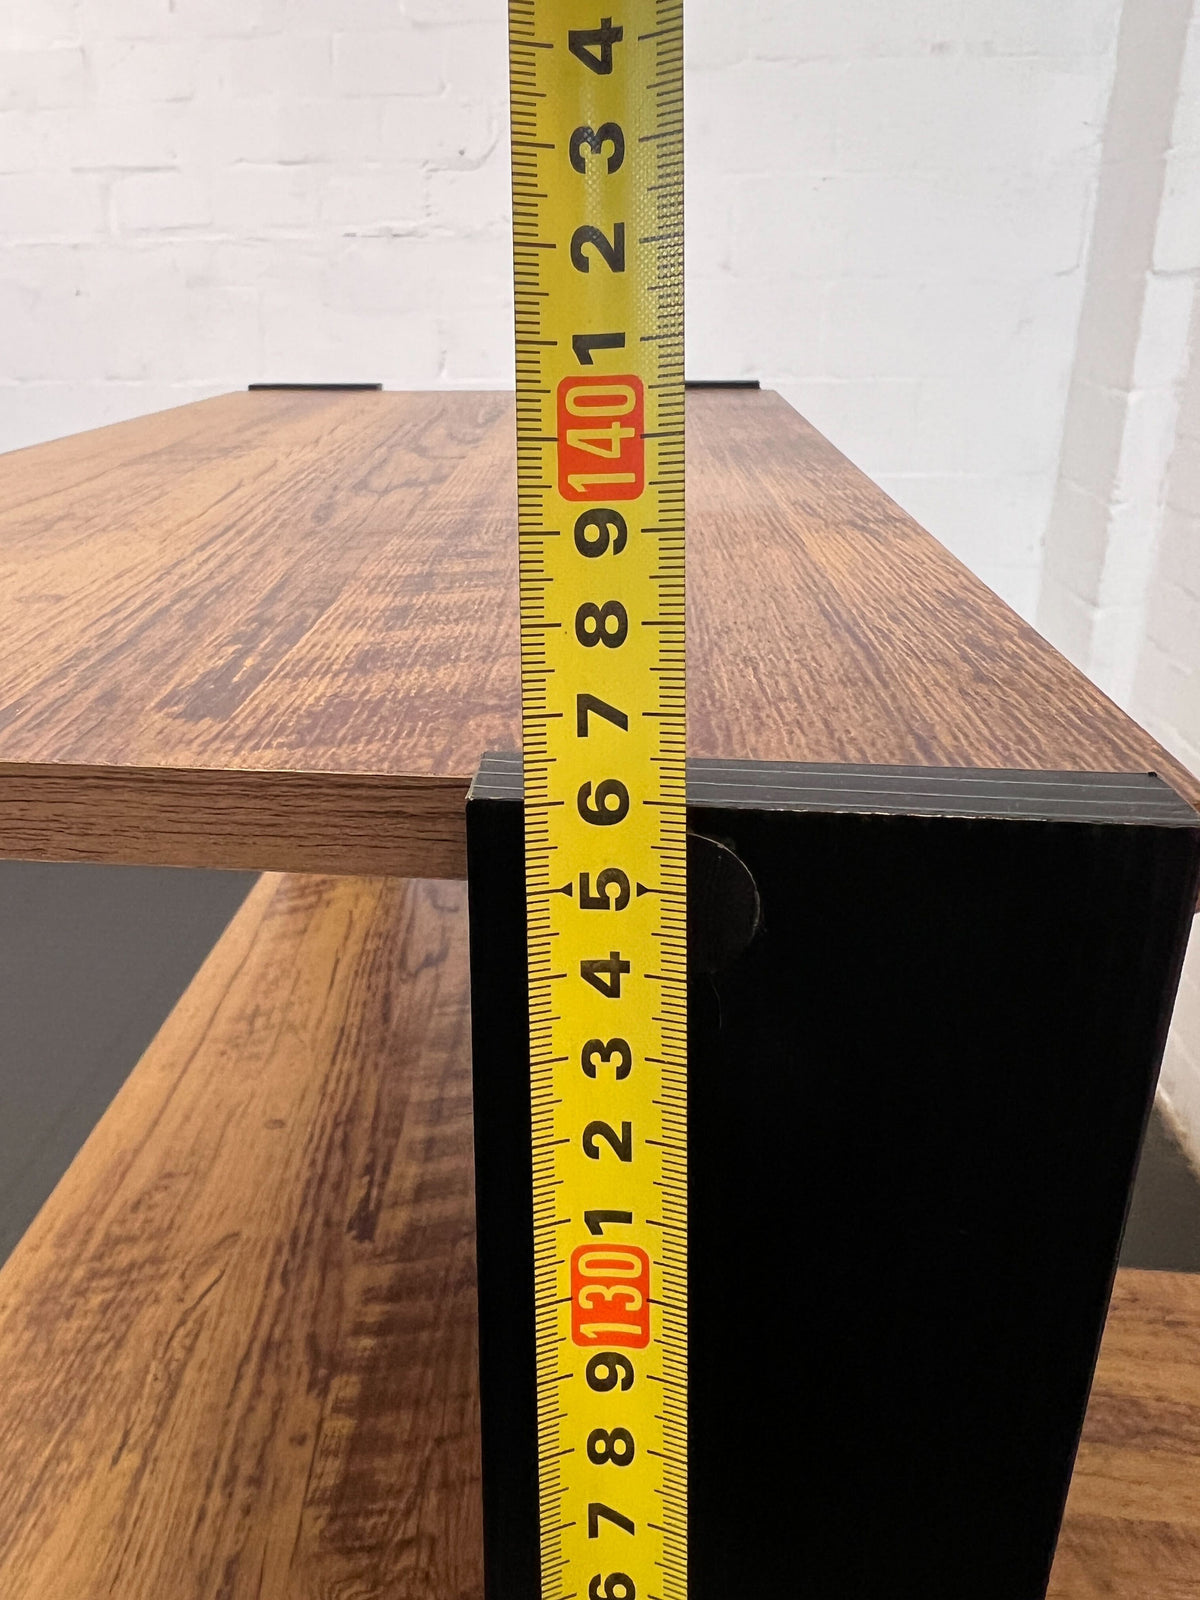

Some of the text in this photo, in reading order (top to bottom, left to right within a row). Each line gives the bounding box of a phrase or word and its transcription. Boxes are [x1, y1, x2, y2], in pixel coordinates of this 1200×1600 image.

[568, 17, 624, 75] 4
[569, 122, 625, 174] 3
[571, 222, 626, 273] 2
[572, 332, 626, 365] 1
[565, 385, 636, 493] 140
[574, 508, 627, 557] 9
[576, 601, 628, 648] 8
[577, 694, 629, 738] 7
[578, 780, 630, 826] 6
[579, 868, 631, 912] 5
[581, 952, 631, 998] 4
[582, 1037, 632, 1080] 3
[583, 1121, 632, 1162] 2
[584, 1210, 633, 1235] 1
[578, 1251, 642, 1338] 130
[586, 1352, 634, 1392] 9
[587, 1428, 635, 1466] 8
[588, 1503, 635, 1538] 7
[589, 1573, 636, 1600] 6
